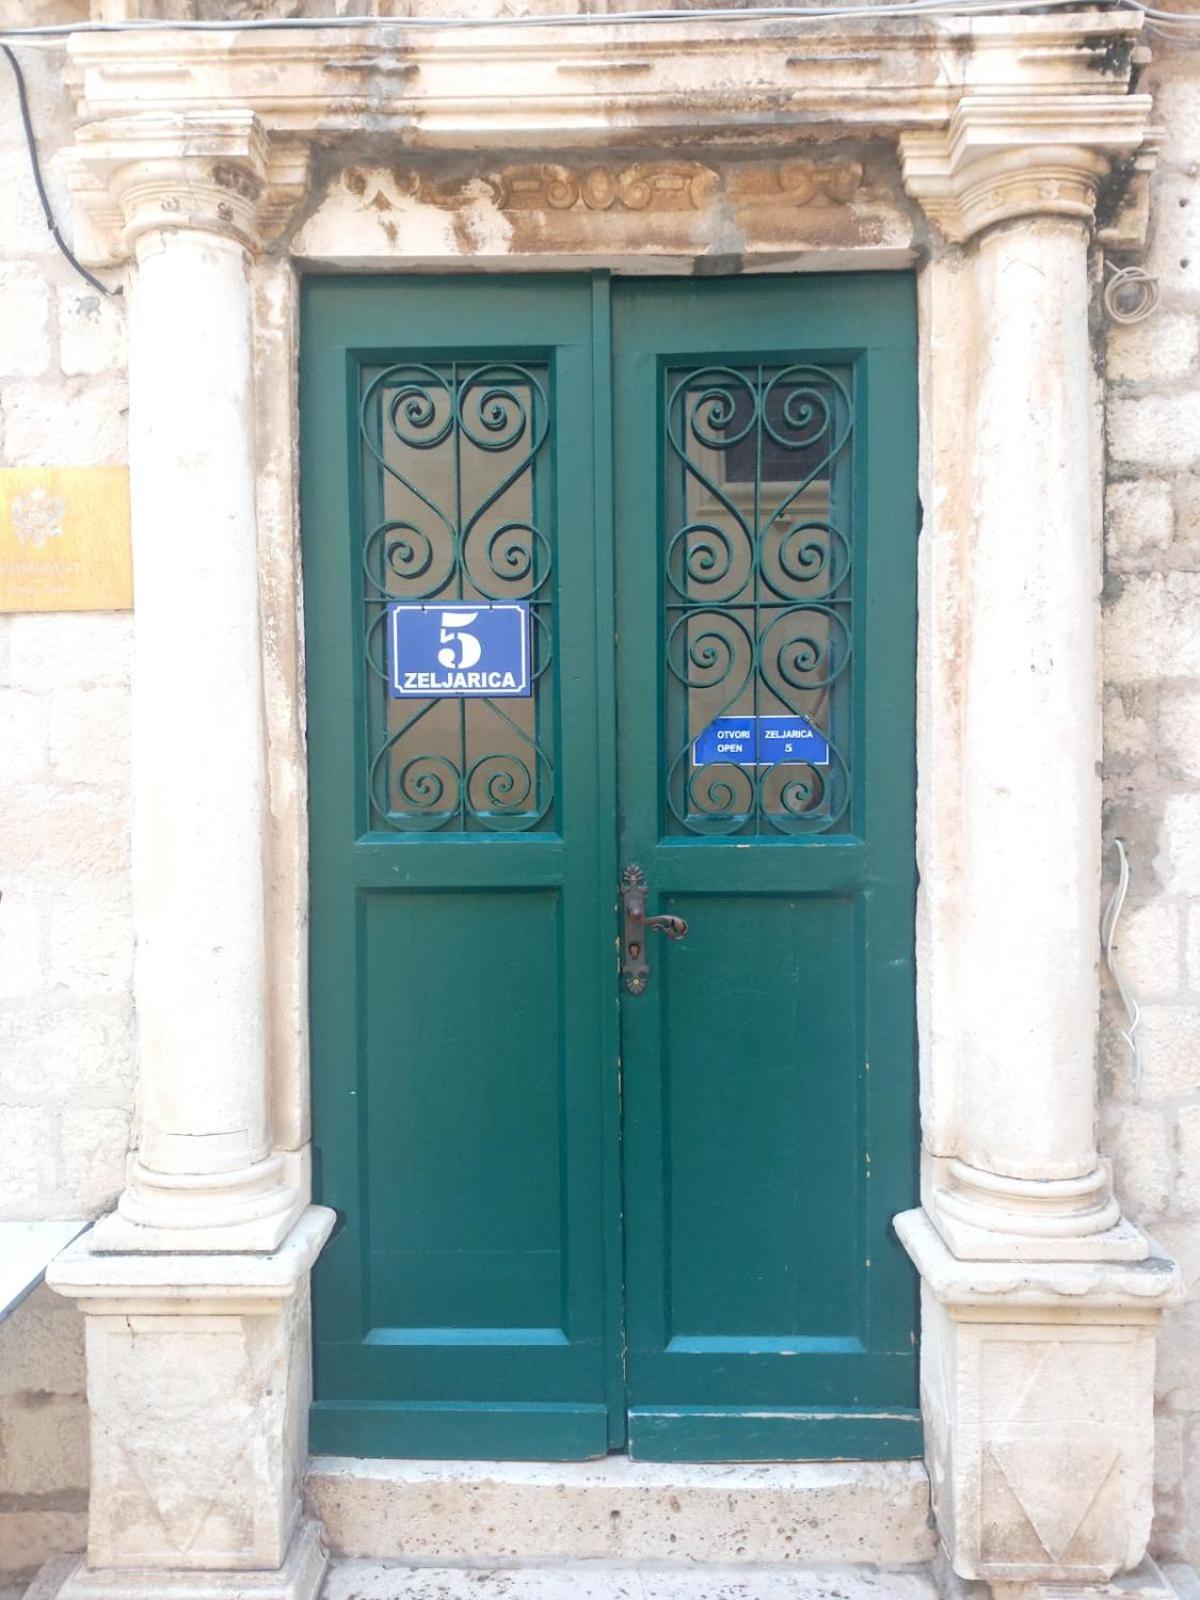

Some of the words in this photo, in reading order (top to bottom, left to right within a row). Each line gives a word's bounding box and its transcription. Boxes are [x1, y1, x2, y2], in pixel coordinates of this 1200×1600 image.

[438, 612, 481, 669] 5
[404, 672, 516, 688] ZELJARICA
[717, 730, 750, 739] OTVORI
[765, 730, 813, 739] ZELJARICA
[717, 744, 742, 753] OPEN
[785, 744, 792, 753] 5
